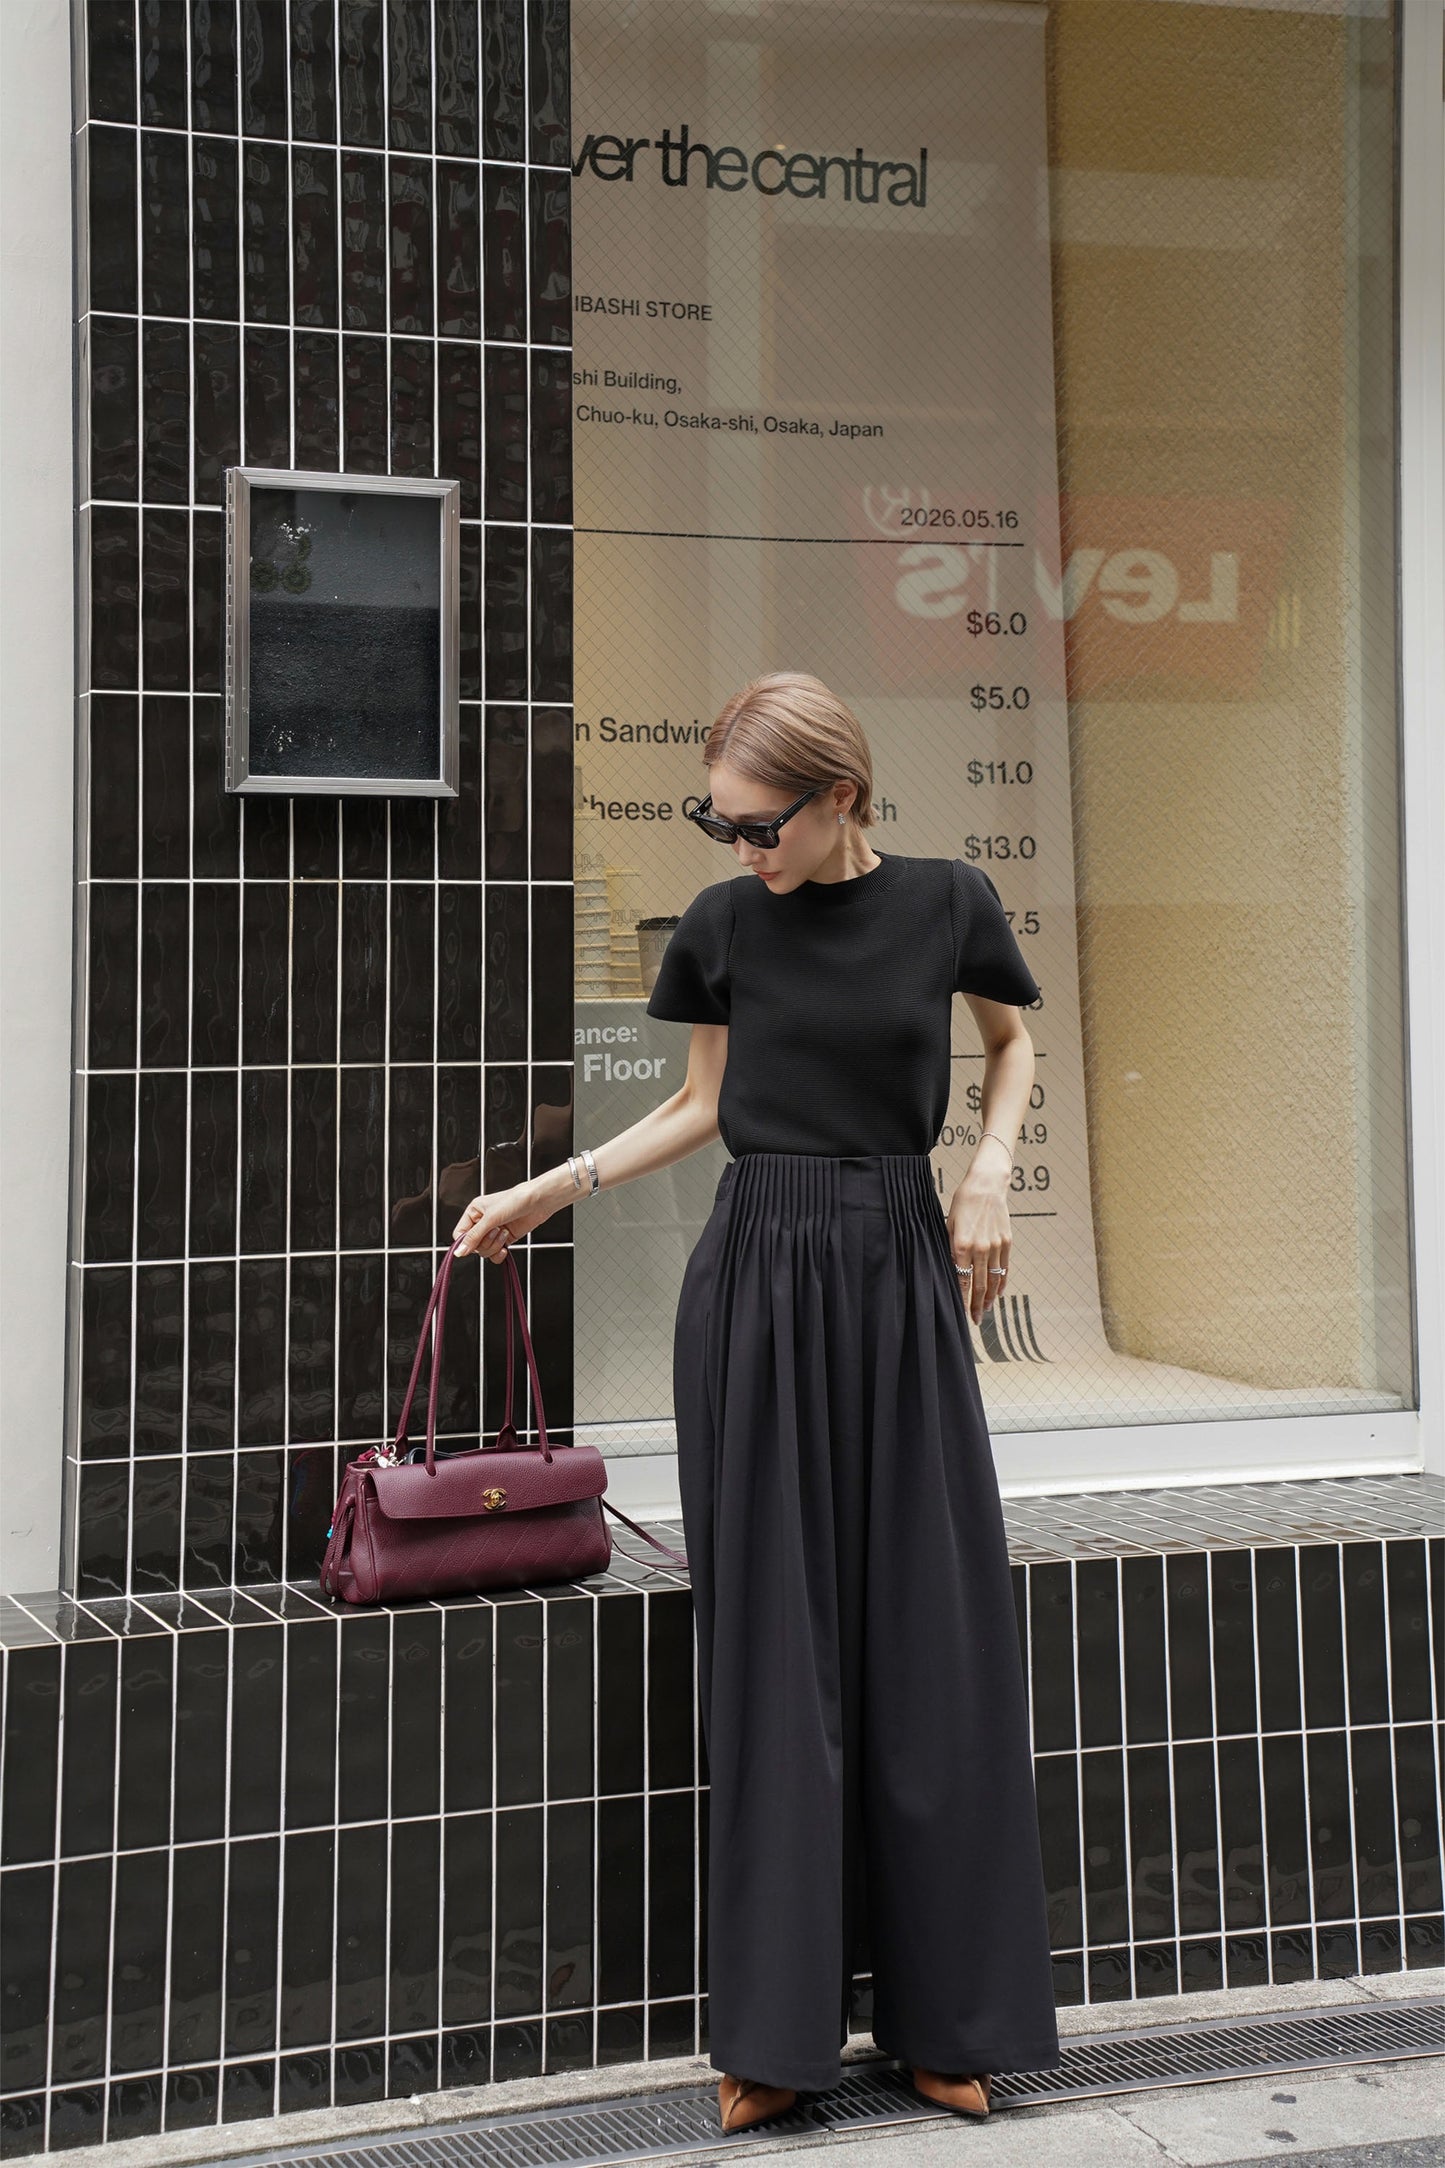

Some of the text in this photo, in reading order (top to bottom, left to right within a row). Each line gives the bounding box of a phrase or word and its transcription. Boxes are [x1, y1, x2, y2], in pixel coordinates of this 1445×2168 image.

[574, 296, 713, 321] IBASHI STORE
[573, 370, 682, 394] shi Building,
[576, 405, 883, 439] Chuo-ku, Osaka-shi, Osaka, Japan
[900, 507, 1019, 528] 2026.05.16
[967, 609, 1027, 638] $6.0
[970, 684, 1030, 713] $5.0
[967, 758, 1033, 787] $11.0
[583, 795, 673, 821] heese
[964, 833, 1036, 862] $13.0
[574, 1026, 638, 1045] ance:
[583, 1053, 667, 1082] Floor
